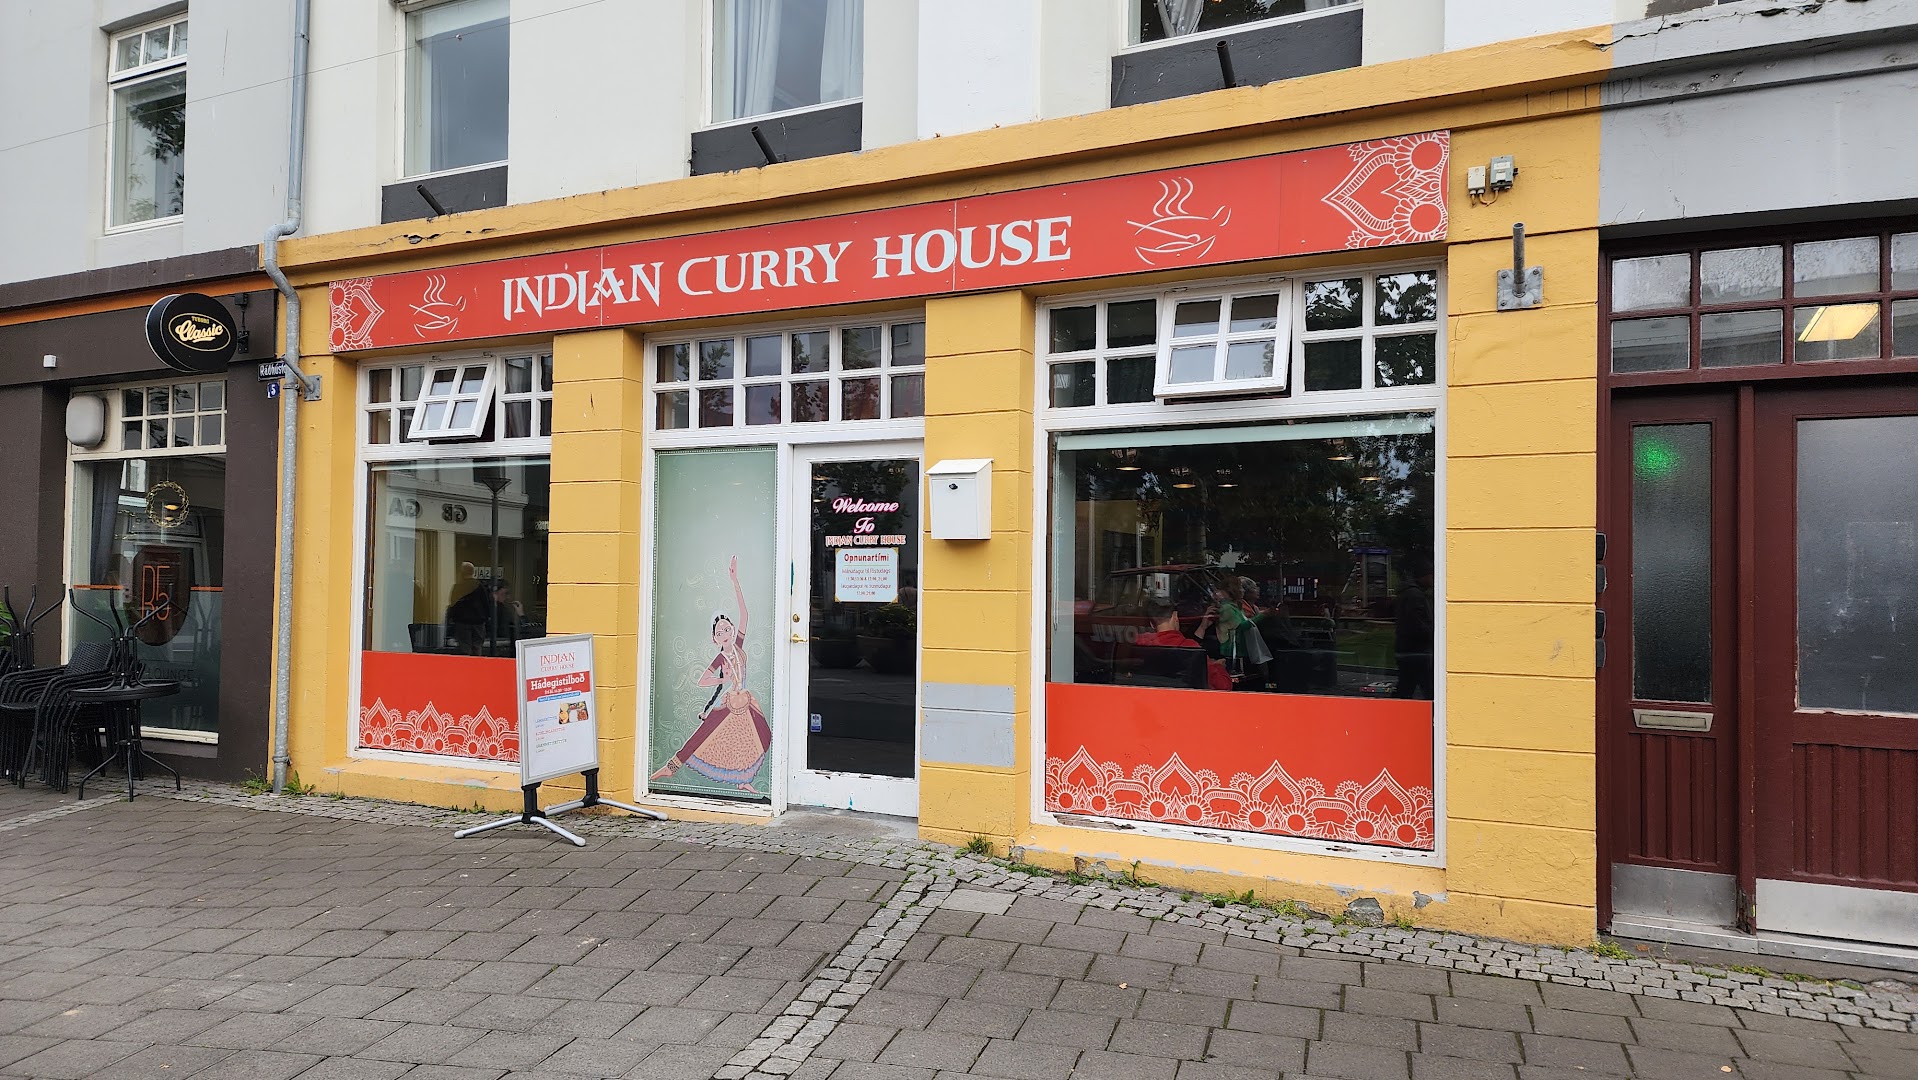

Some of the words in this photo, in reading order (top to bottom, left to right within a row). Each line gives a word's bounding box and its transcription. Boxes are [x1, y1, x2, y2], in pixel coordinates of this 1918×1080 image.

[503, 261, 664, 321] INDIAN
[678, 241, 852, 296] CURRY
[871, 215, 1073, 280] HOUSE
[175, 319, 224, 342] Classic
[270, 383, 277, 396] 5
[832, 497, 900, 514] Welcome
[853, 516, 876, 534] To
[825, 535, 853, 547] INDIAN
[880, 535, 906, 545] HOUSE
[844, 552, 890, 563] Opnunartími
[540, 652, 575, 667] INDIAN
[531, 672, 585, 691] Hádegistilboð
